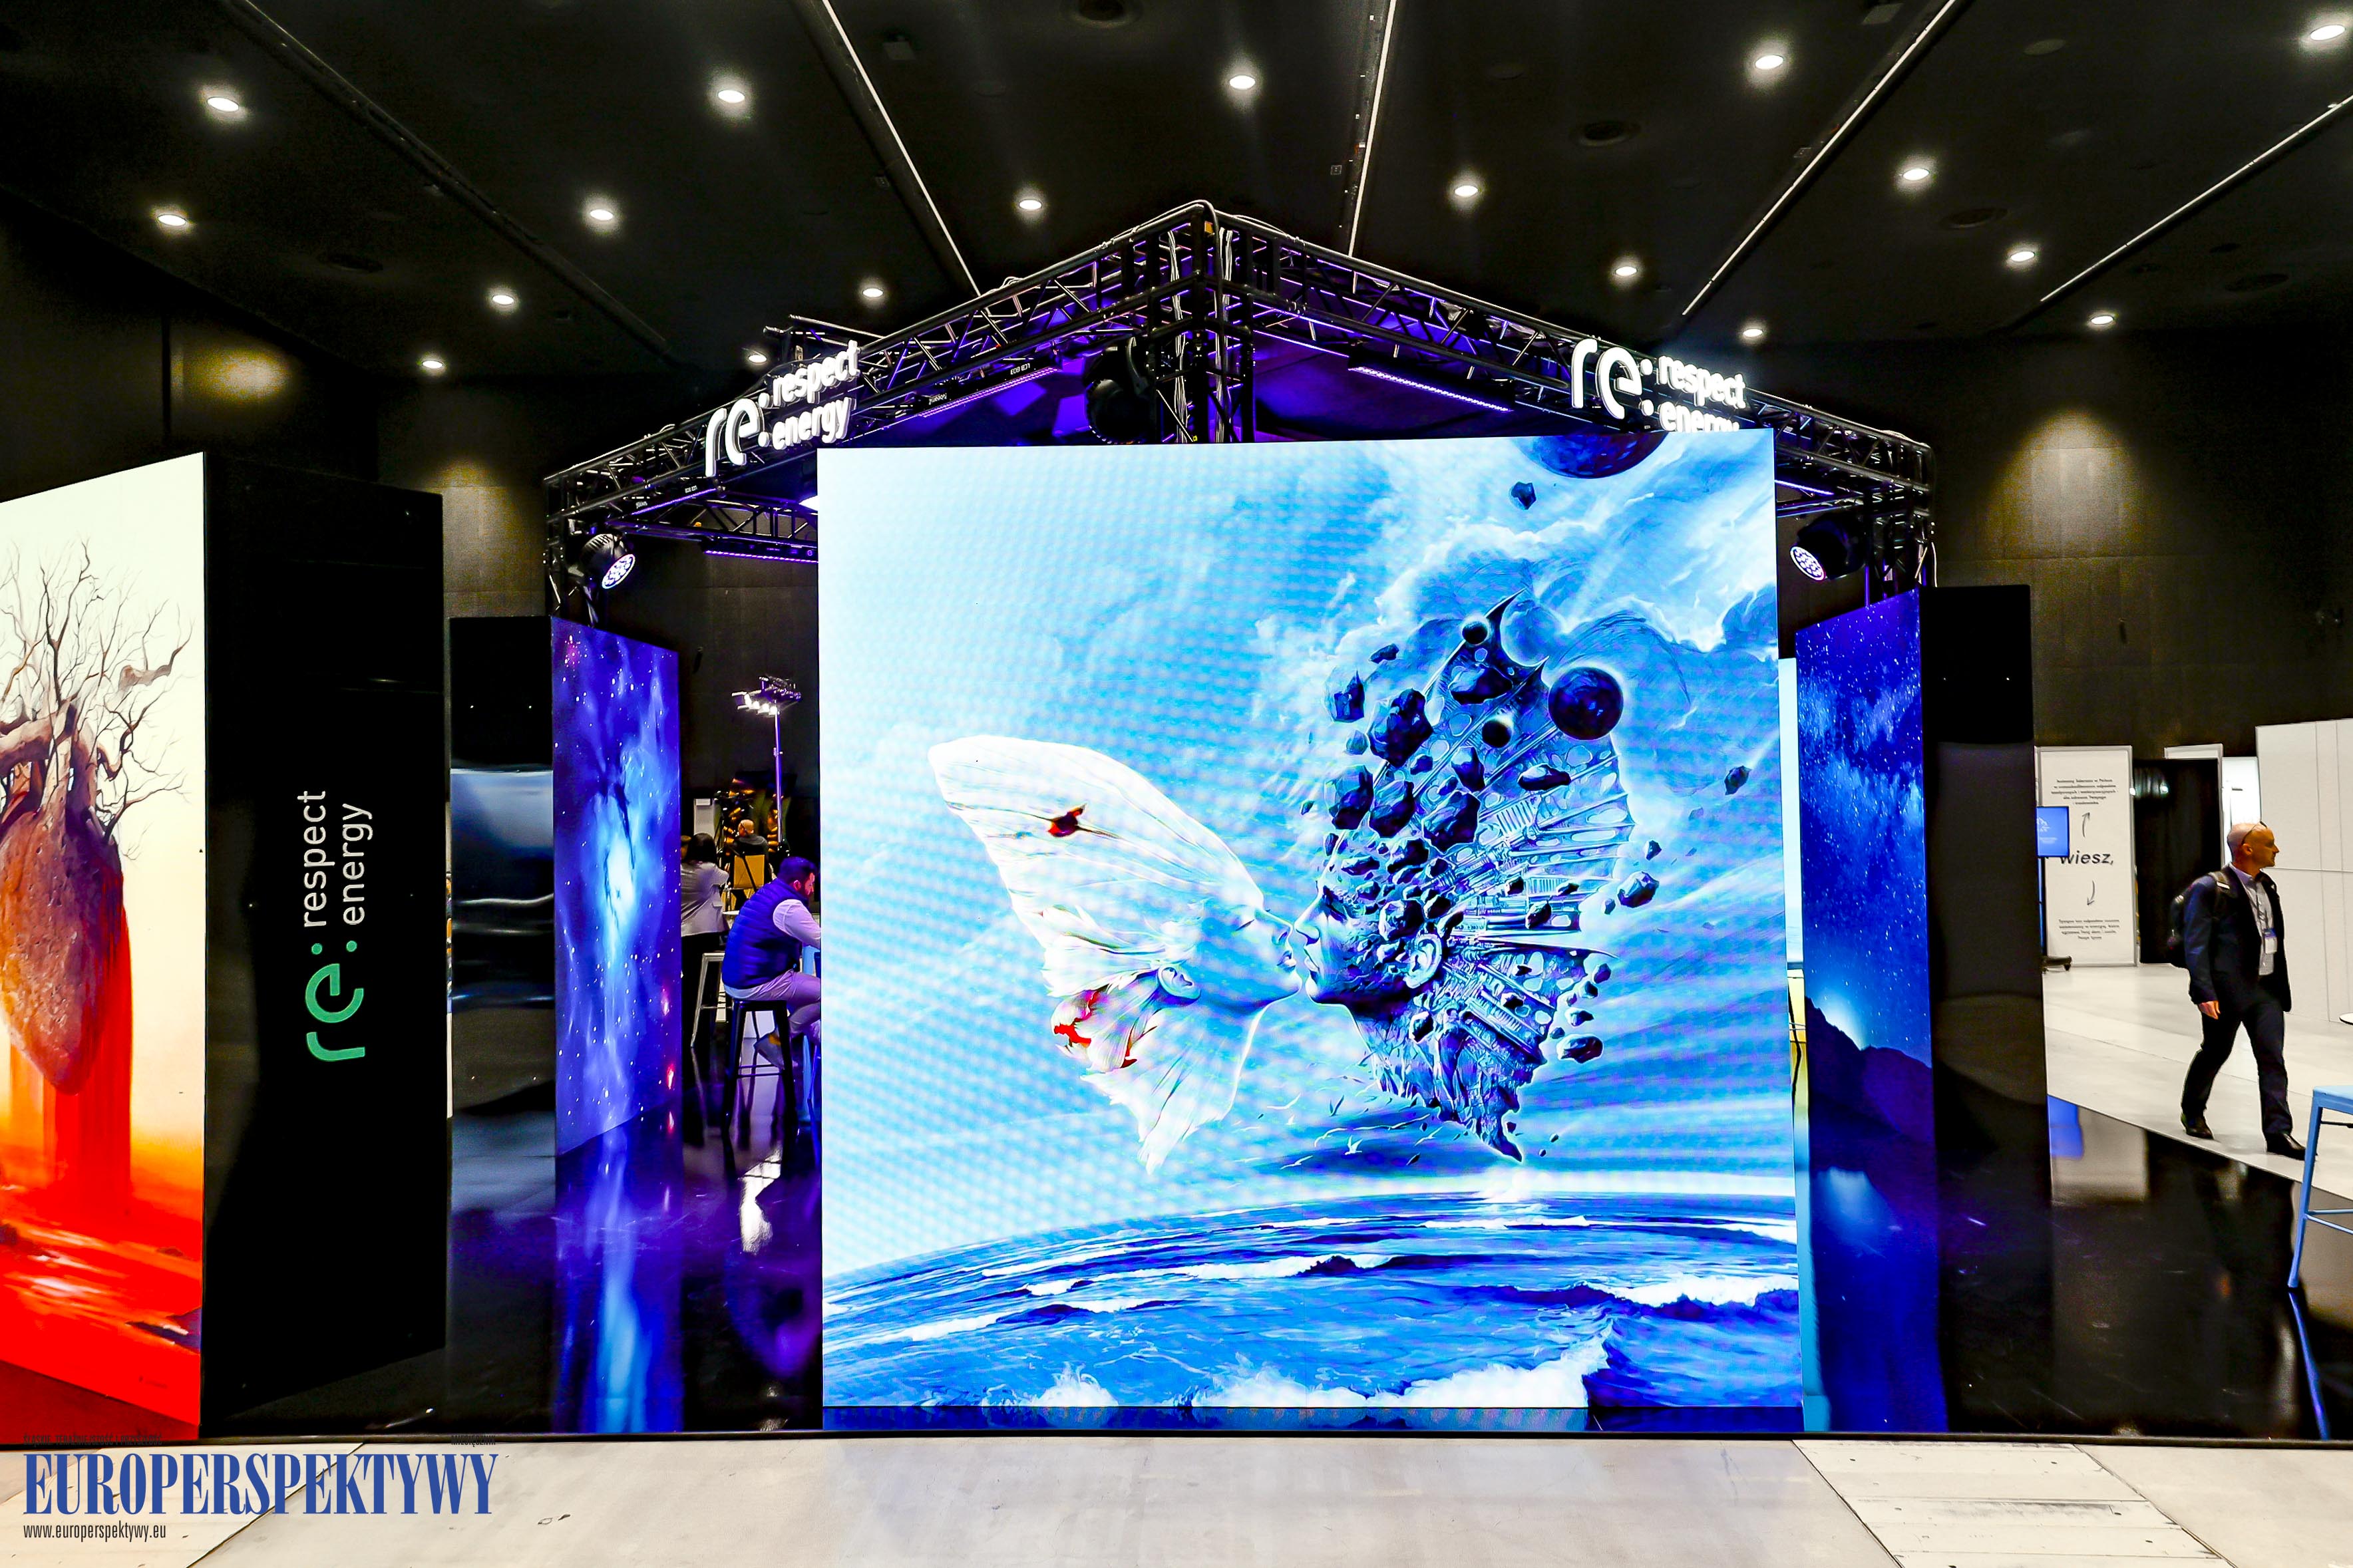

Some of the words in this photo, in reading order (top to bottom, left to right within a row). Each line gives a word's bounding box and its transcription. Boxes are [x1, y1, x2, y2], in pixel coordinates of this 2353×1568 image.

[773, 339, 860, 407] respect
[1656, 355, 1746, 409] respect
[772, 397, 856, 450] energy
[297, 790, 335, 927] respect
[342, 803, 373, 925] energy
[2060, 850, 2113, 865] wiesz,
